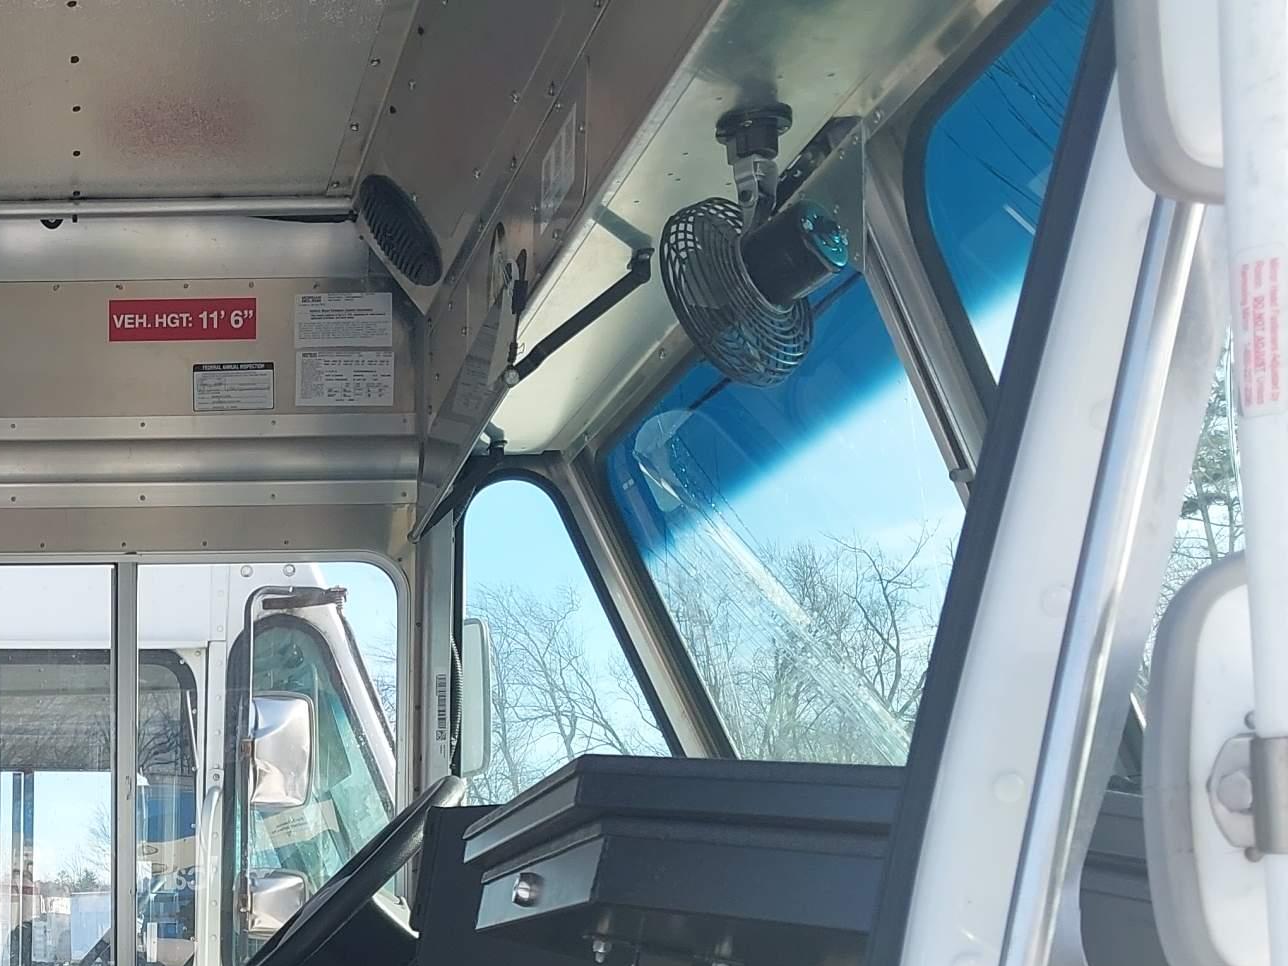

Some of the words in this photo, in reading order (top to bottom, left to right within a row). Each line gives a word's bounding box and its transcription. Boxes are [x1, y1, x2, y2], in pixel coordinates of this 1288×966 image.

[112, 313, 152, 329] VEH.
[155, 312, 193, 328] HGT:
[1254, 312, 1266, 332] NOT
[1254, 335, 1267, 373] ADJUST
